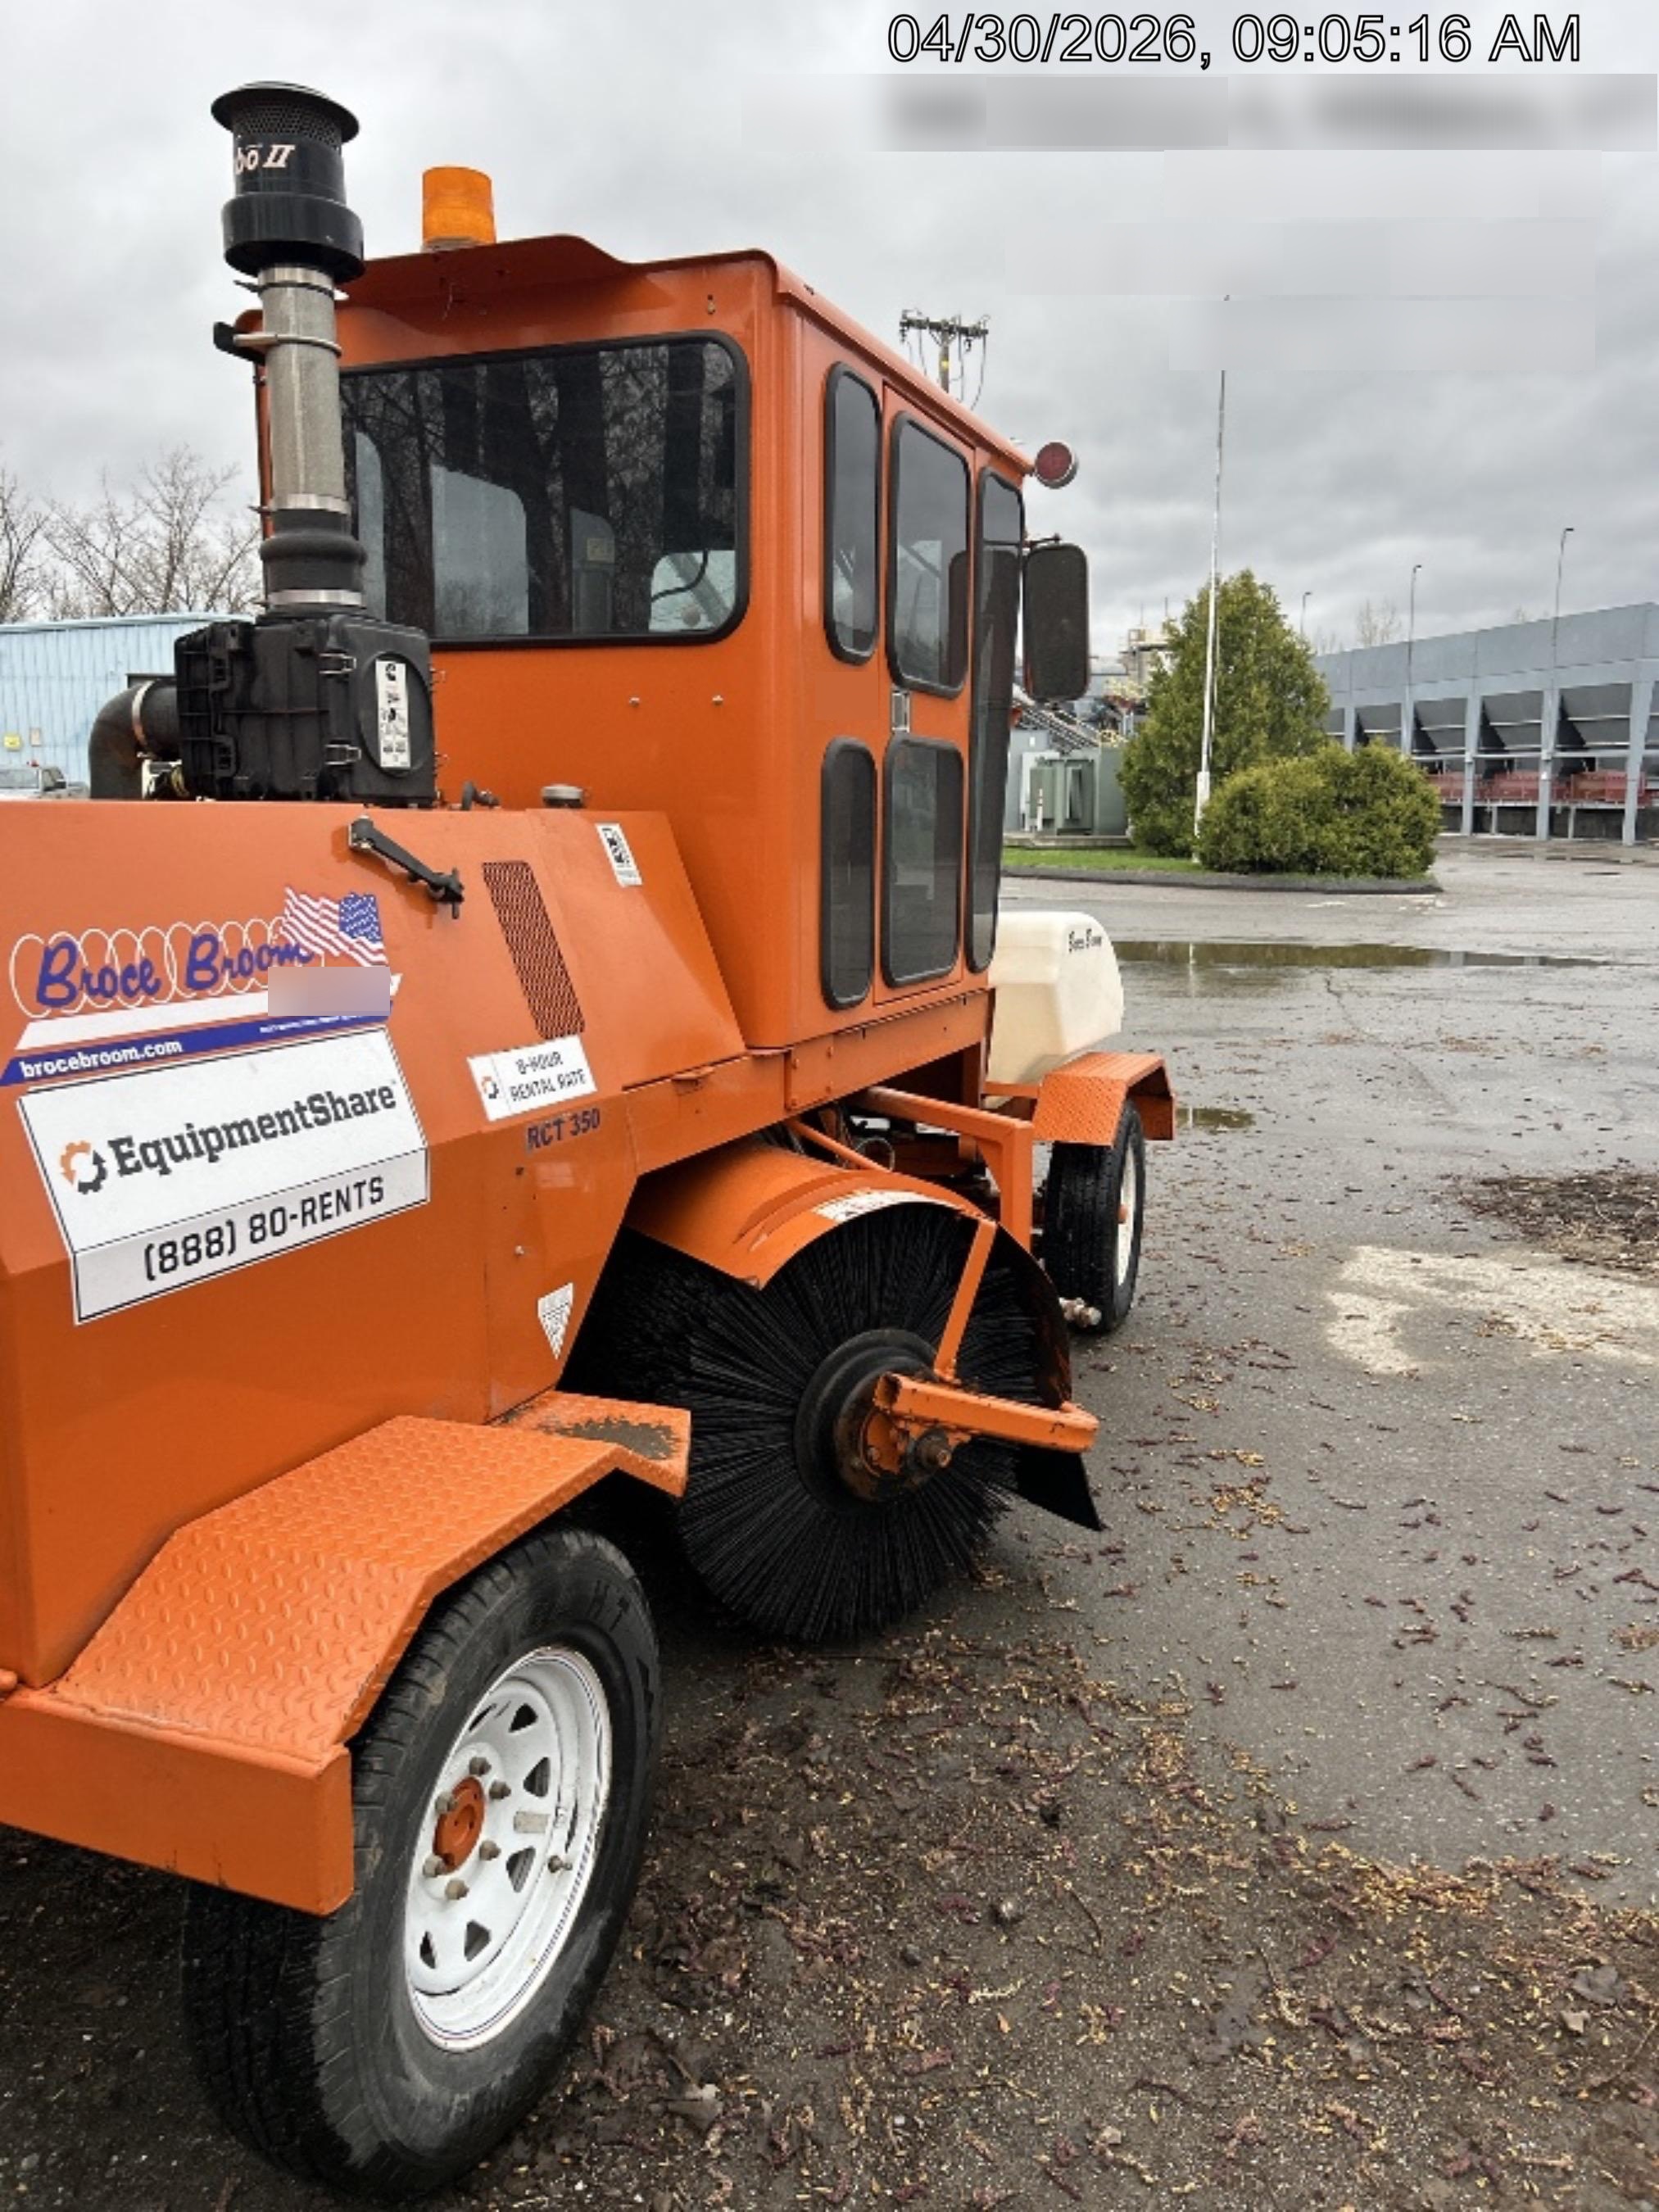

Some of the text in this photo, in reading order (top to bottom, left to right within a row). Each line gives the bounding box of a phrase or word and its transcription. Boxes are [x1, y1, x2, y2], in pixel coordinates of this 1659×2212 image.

[35, 940, 161, 1009] Broce
[20, 1039, 183, 1079] brocebroom.com
[510, 1068, 587, 1102] RENTAL RATE
[107, 1085, 397, 1177] EquipmentShare
[527, 1108, 601, 1149] RCT 350
[144, 1176, 384, 1281] (888) 80-RENTS
